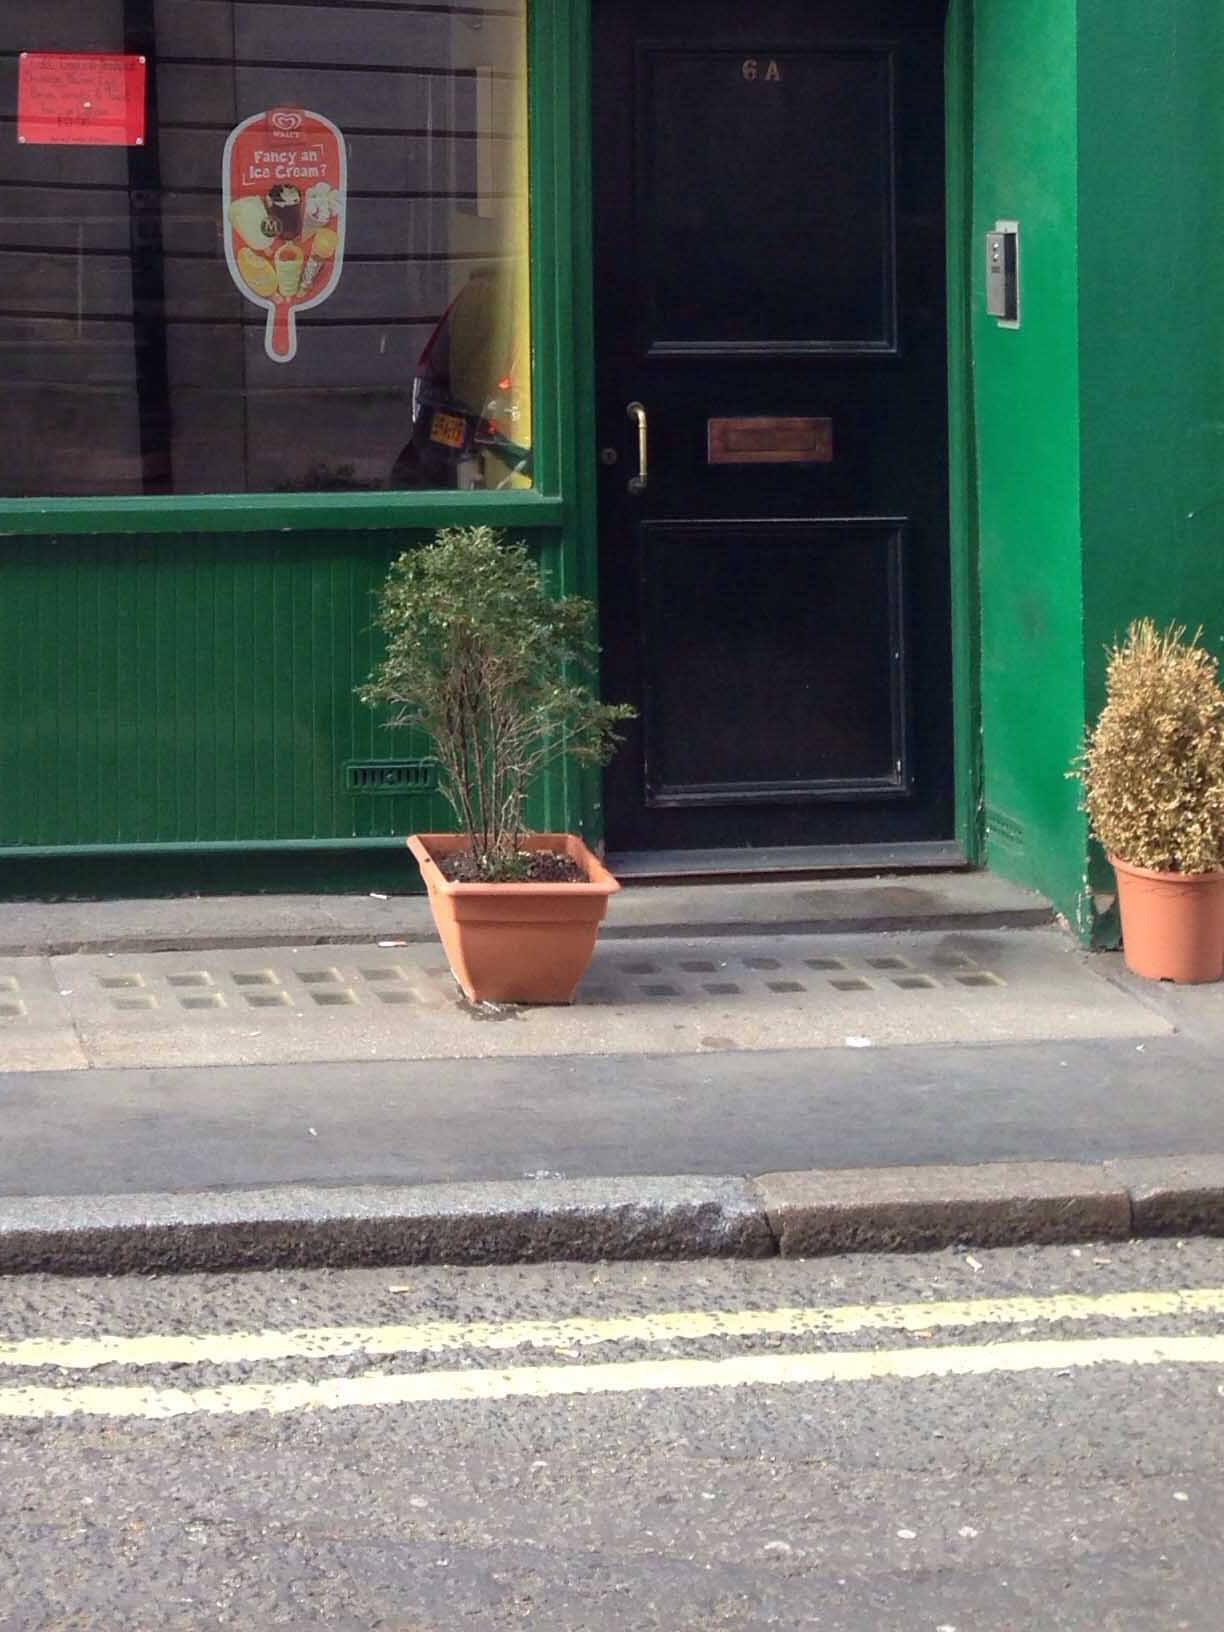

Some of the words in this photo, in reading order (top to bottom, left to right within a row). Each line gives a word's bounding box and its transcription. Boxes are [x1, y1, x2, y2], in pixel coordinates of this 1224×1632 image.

[254, 151, 297, 165] Fancy
[301, 152, 317, 161] an
[249, 166, 270, 179] Ice
[276, 165, 328, 179] Cream?
